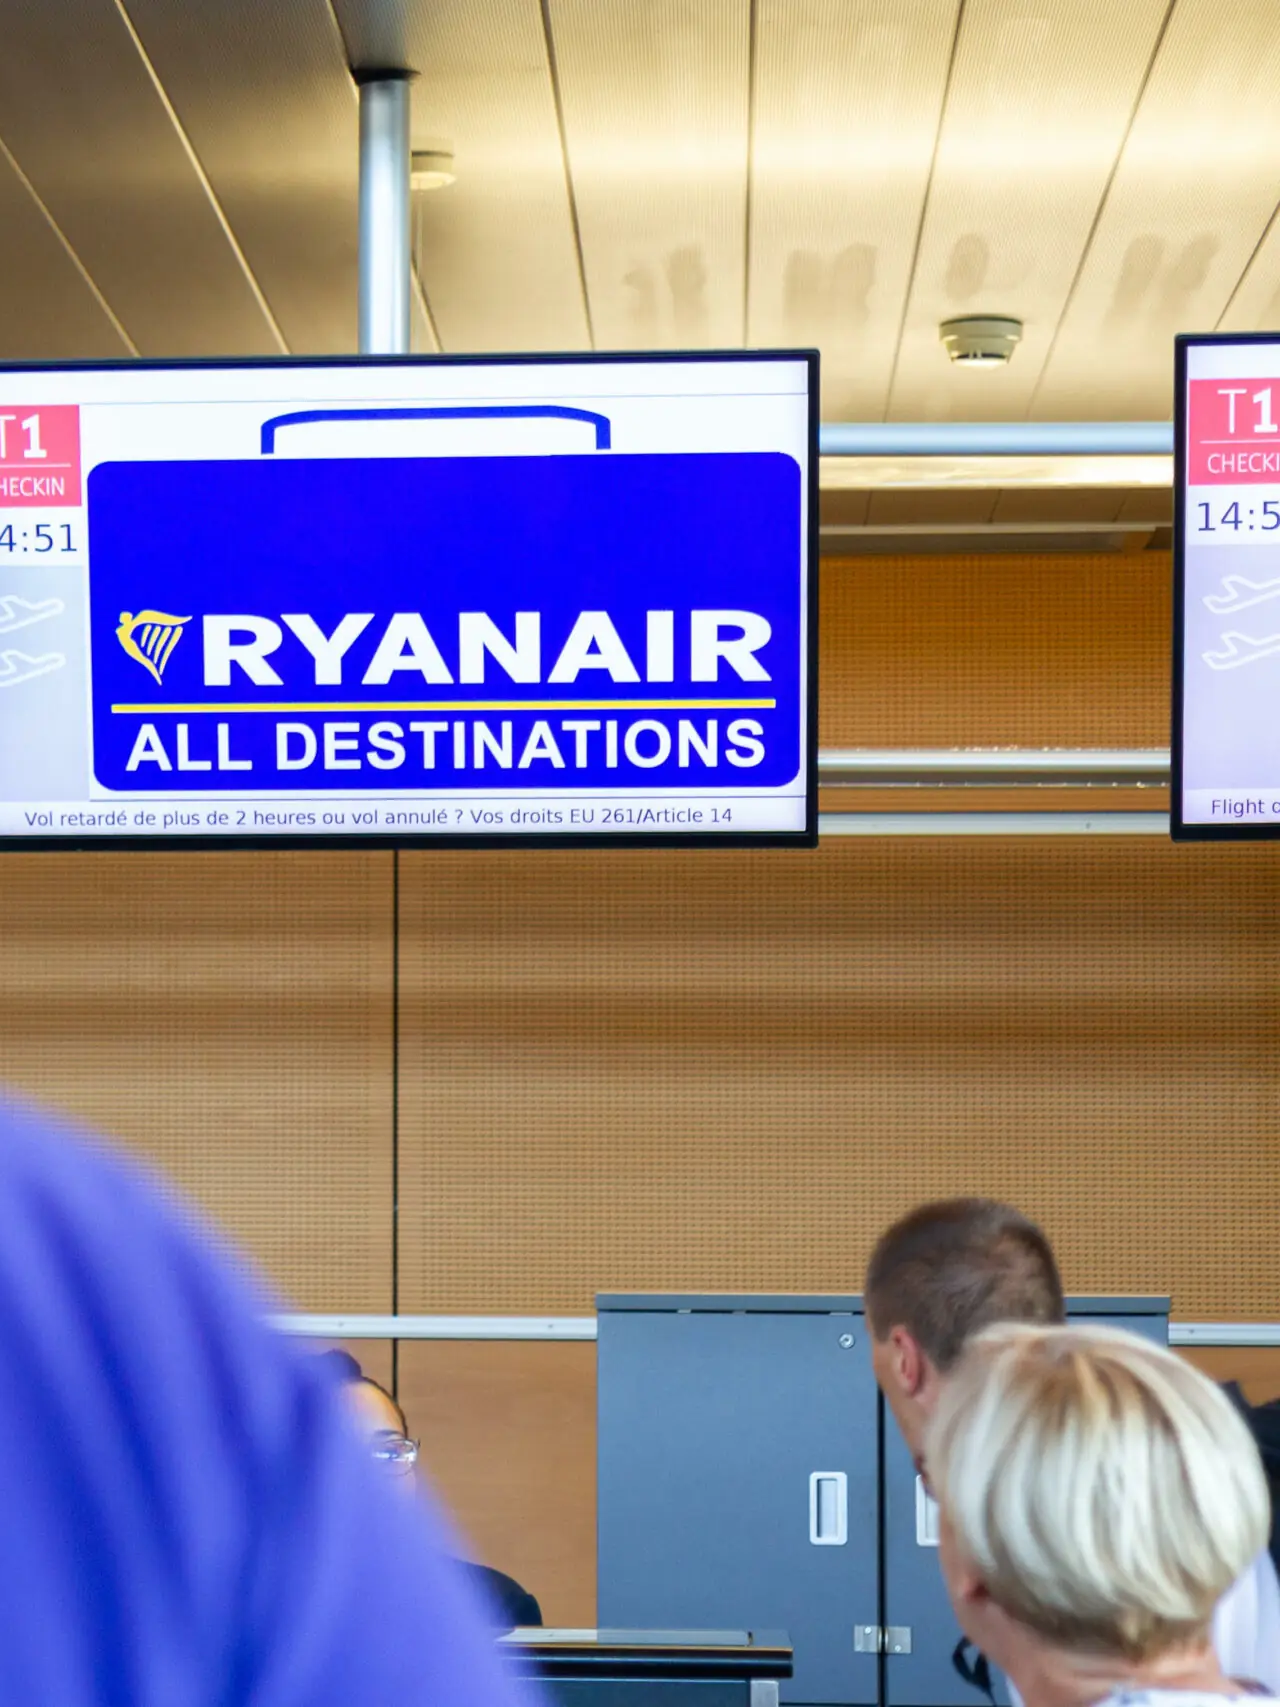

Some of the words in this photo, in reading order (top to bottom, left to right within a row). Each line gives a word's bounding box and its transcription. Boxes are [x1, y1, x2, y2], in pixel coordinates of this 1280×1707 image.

[1217, 387, 1279, 434] T1
[202, 609, 772, 686] RYANAIR
[125, 722, 252, 772] ALL
[275, 718, 766, 771] DESTINATIONS
[25, 811, 53, 827] Vol
[60, 810, 128, 827] retardé
[133, 810, 157, 826] de
[163, 810, 201, 830] plus
[206, 810, 229, 826] de
[236, 810, 247, 826] 2
[253, 809, 317, 826] heures
[322, 812, 346, 826] ou
[351, 809, 378, 825] vol
[384, 808, 449, 825] annulé
[454, 809, 464, 825] ?
[469, 809, 504, 825] Vos
[510, 808, 564, 825] droits
[570, 808, 595, 824] EU
[601, 807, 704, 825] 261/Article
[710, 808, 733, 824] 14
[1211, 798, 1265, 818] Flight
